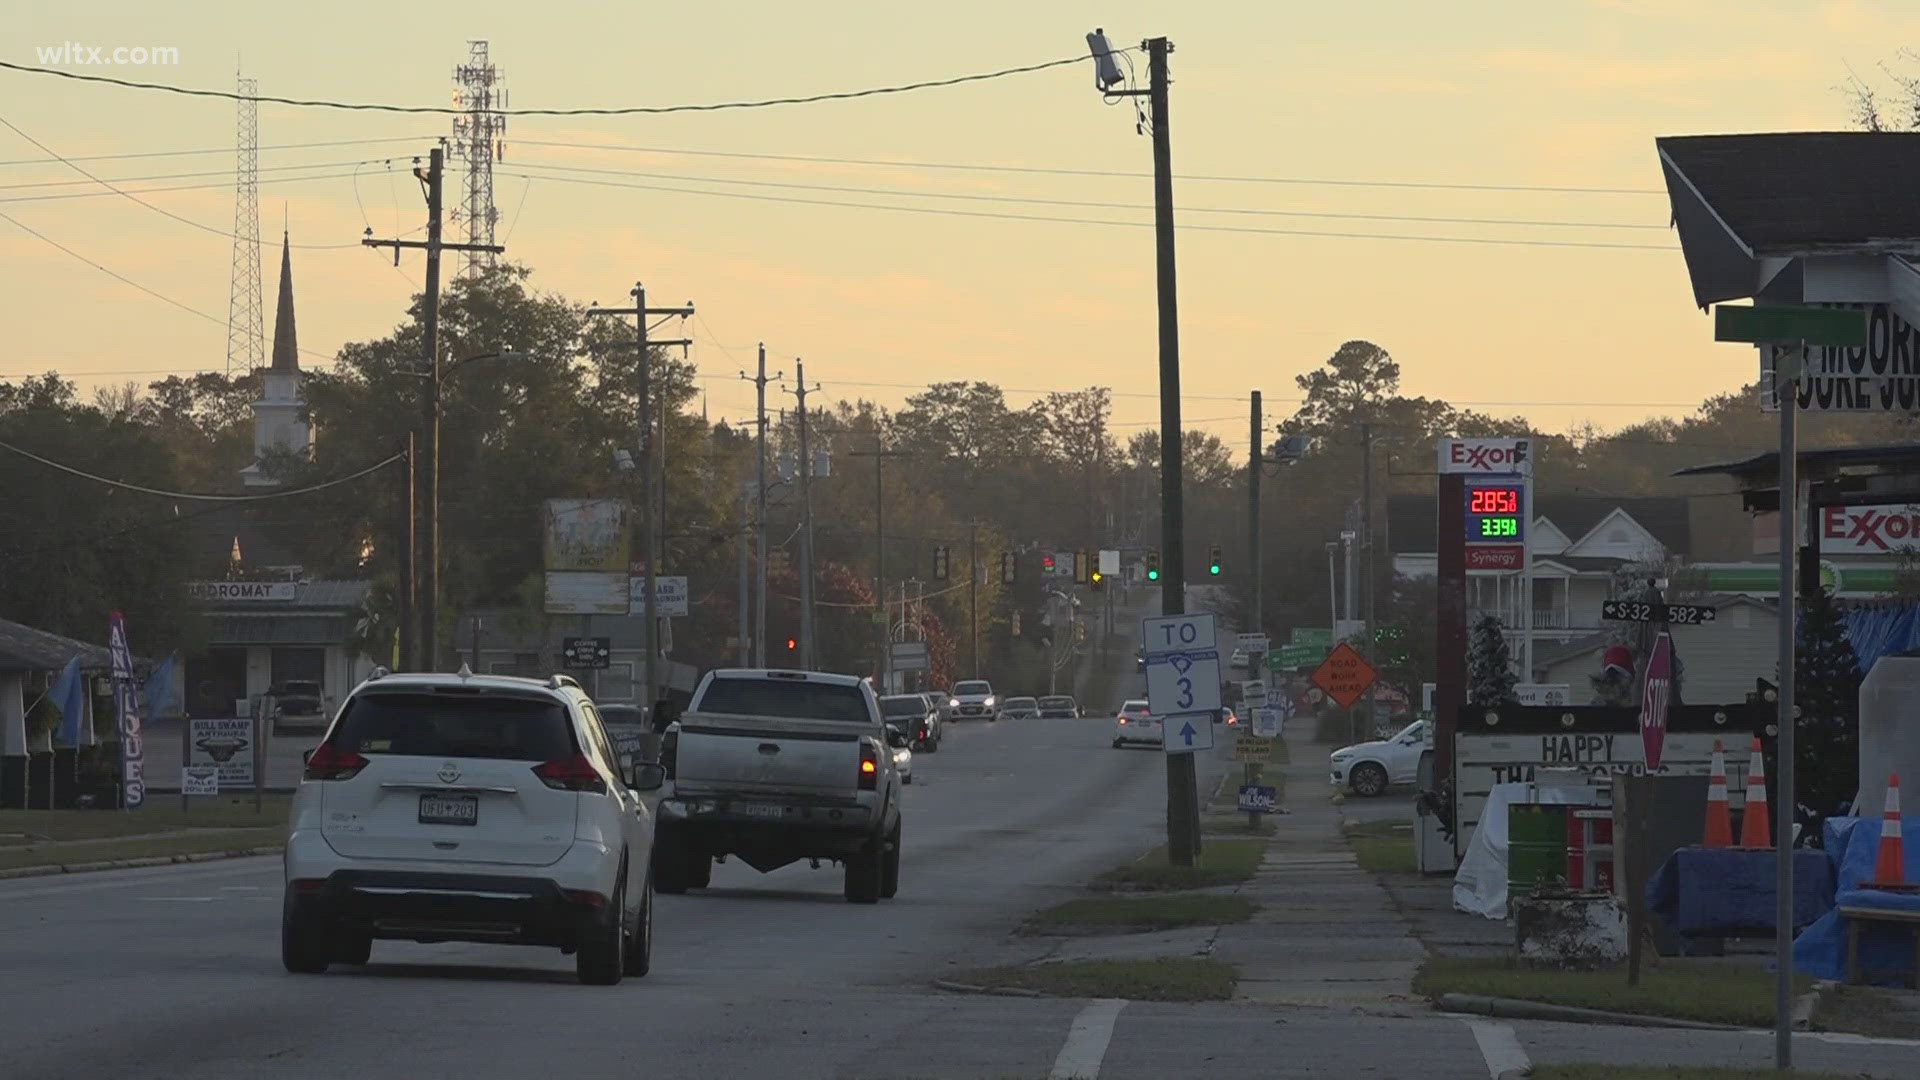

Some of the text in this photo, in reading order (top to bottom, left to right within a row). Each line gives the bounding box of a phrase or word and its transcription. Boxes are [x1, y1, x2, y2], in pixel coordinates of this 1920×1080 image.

[1821, 303, 1920, 374] MOOR
[1472, 552, 1516, 565] Synergy
[1668, 607, 1697, 623] 582
[1160, 623, 1196, 645] TO
[1330, 659, 1357, 668] ROAD
[1331, 672, 1357, 680] WORK
[1177, 678, 1193, 709] 3
[1329, 684, 1361, 693] AHEAD
[1644, 678, 1668, 728] STOP
[194, 721, 250, 730] BULL SWAMP
[1541, 735, 1613, 761] HAPPY
[1239, 794, 1271, 808] WILSON
[453, 804, 474, 817] 203
